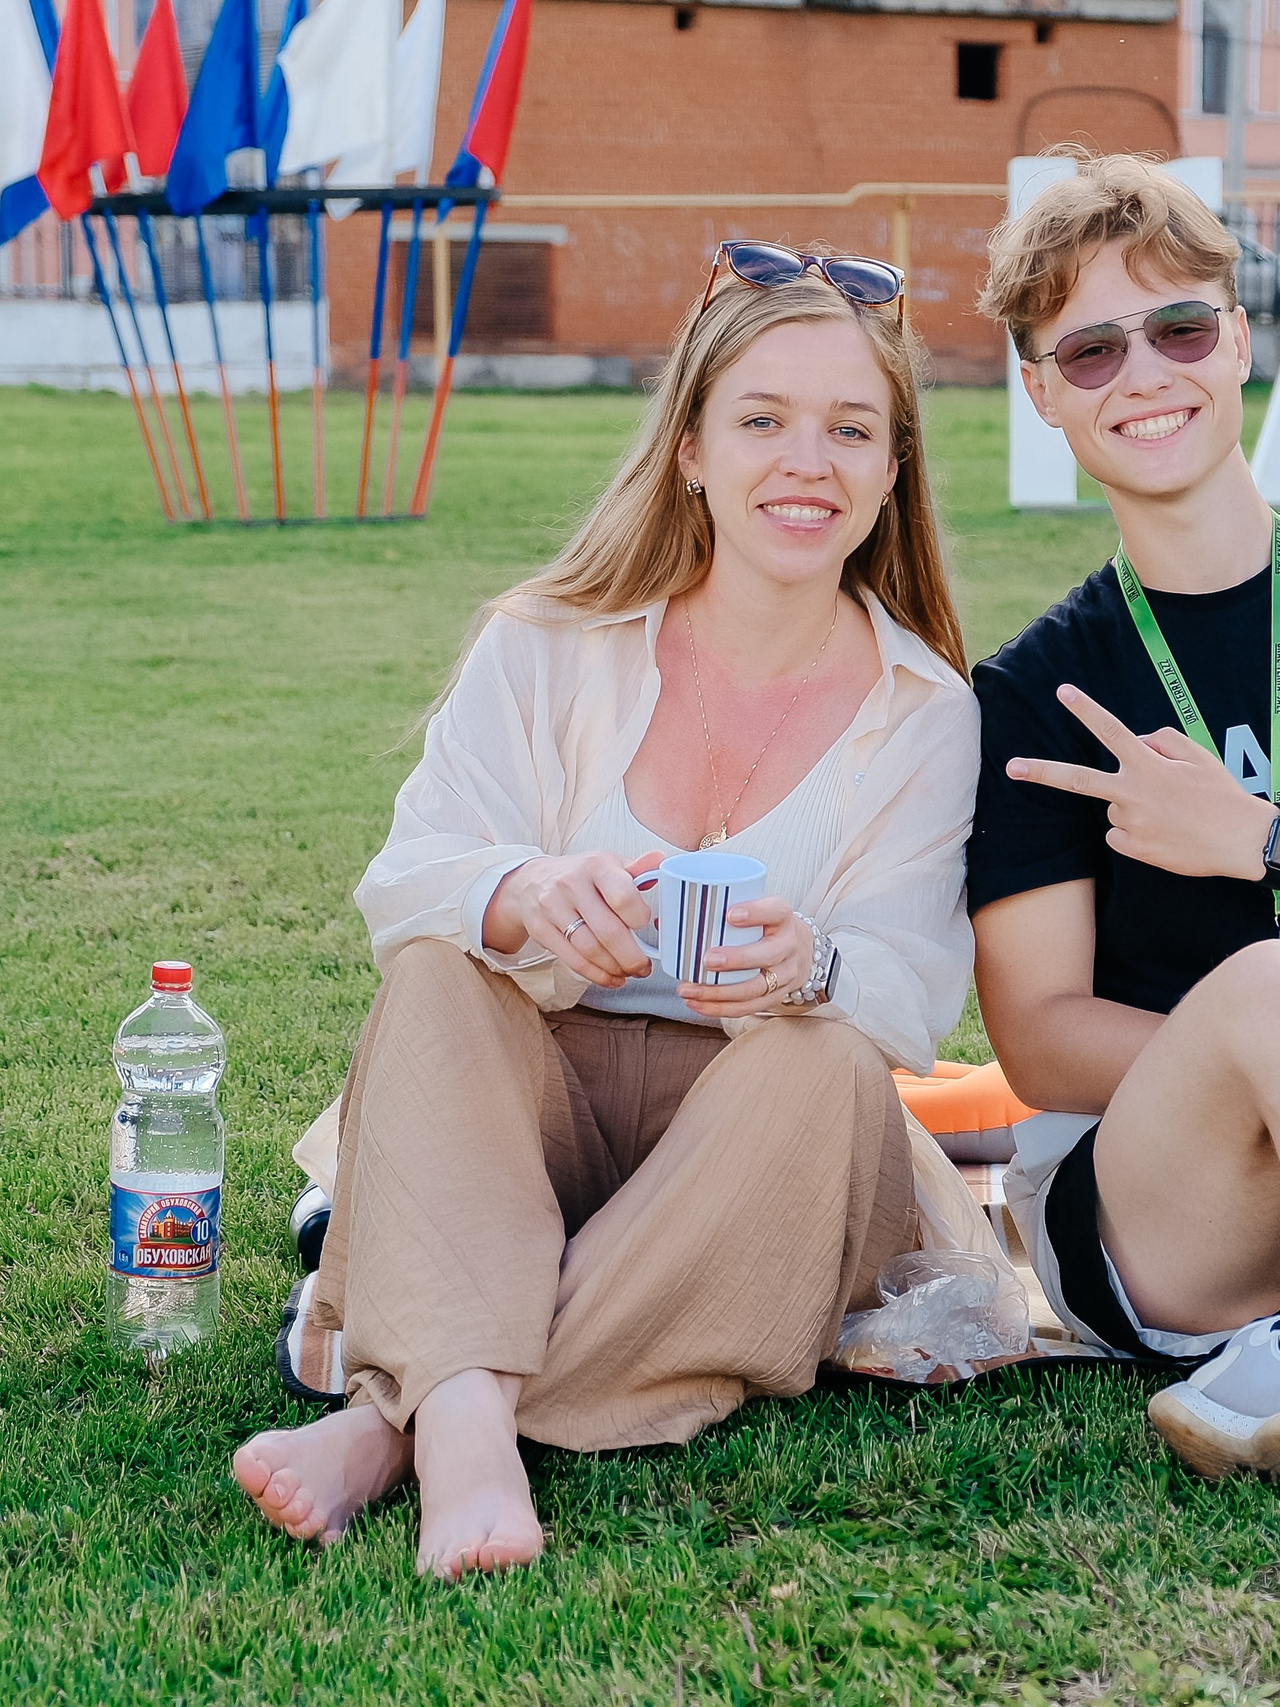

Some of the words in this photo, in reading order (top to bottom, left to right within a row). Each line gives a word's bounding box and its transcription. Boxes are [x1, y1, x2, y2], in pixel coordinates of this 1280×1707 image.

[1160, 659, 1174, 676] JAZZ
[1169, 679, 1186, 704] TERRA
[1182, 704, 1197, 725] URAL
[195, 1219, 210, 1242] 10
[137, 1245, 212, 1265] ОБУХОВСКАЯ
